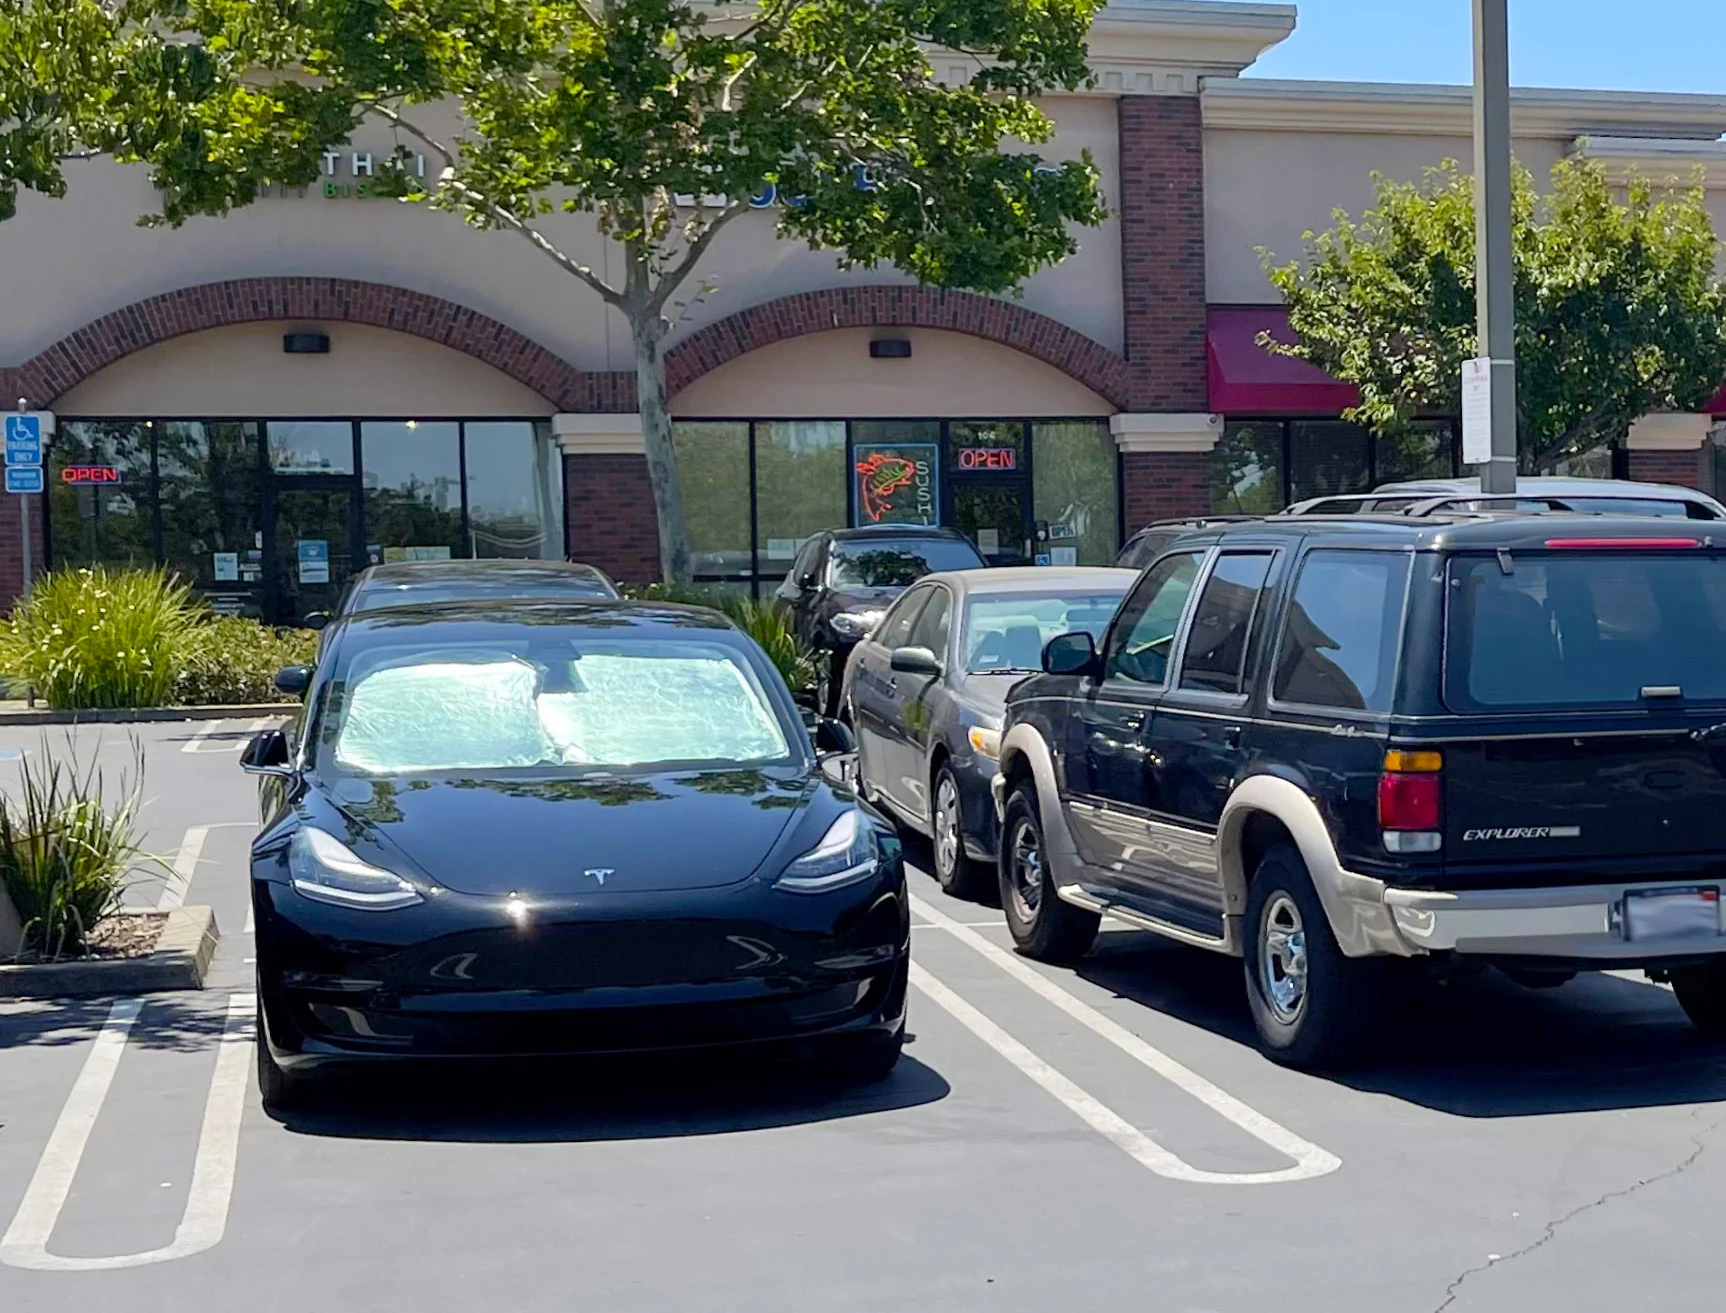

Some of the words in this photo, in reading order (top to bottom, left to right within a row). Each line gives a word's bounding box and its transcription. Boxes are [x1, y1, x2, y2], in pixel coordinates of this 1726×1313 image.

[961, 450, 1014, 469] OPEN
[61, 468, 118, 483] OPEN
[915, 460, 932, 526] SUSHI
[1463, 826, 1549, 841] EXPLORER
